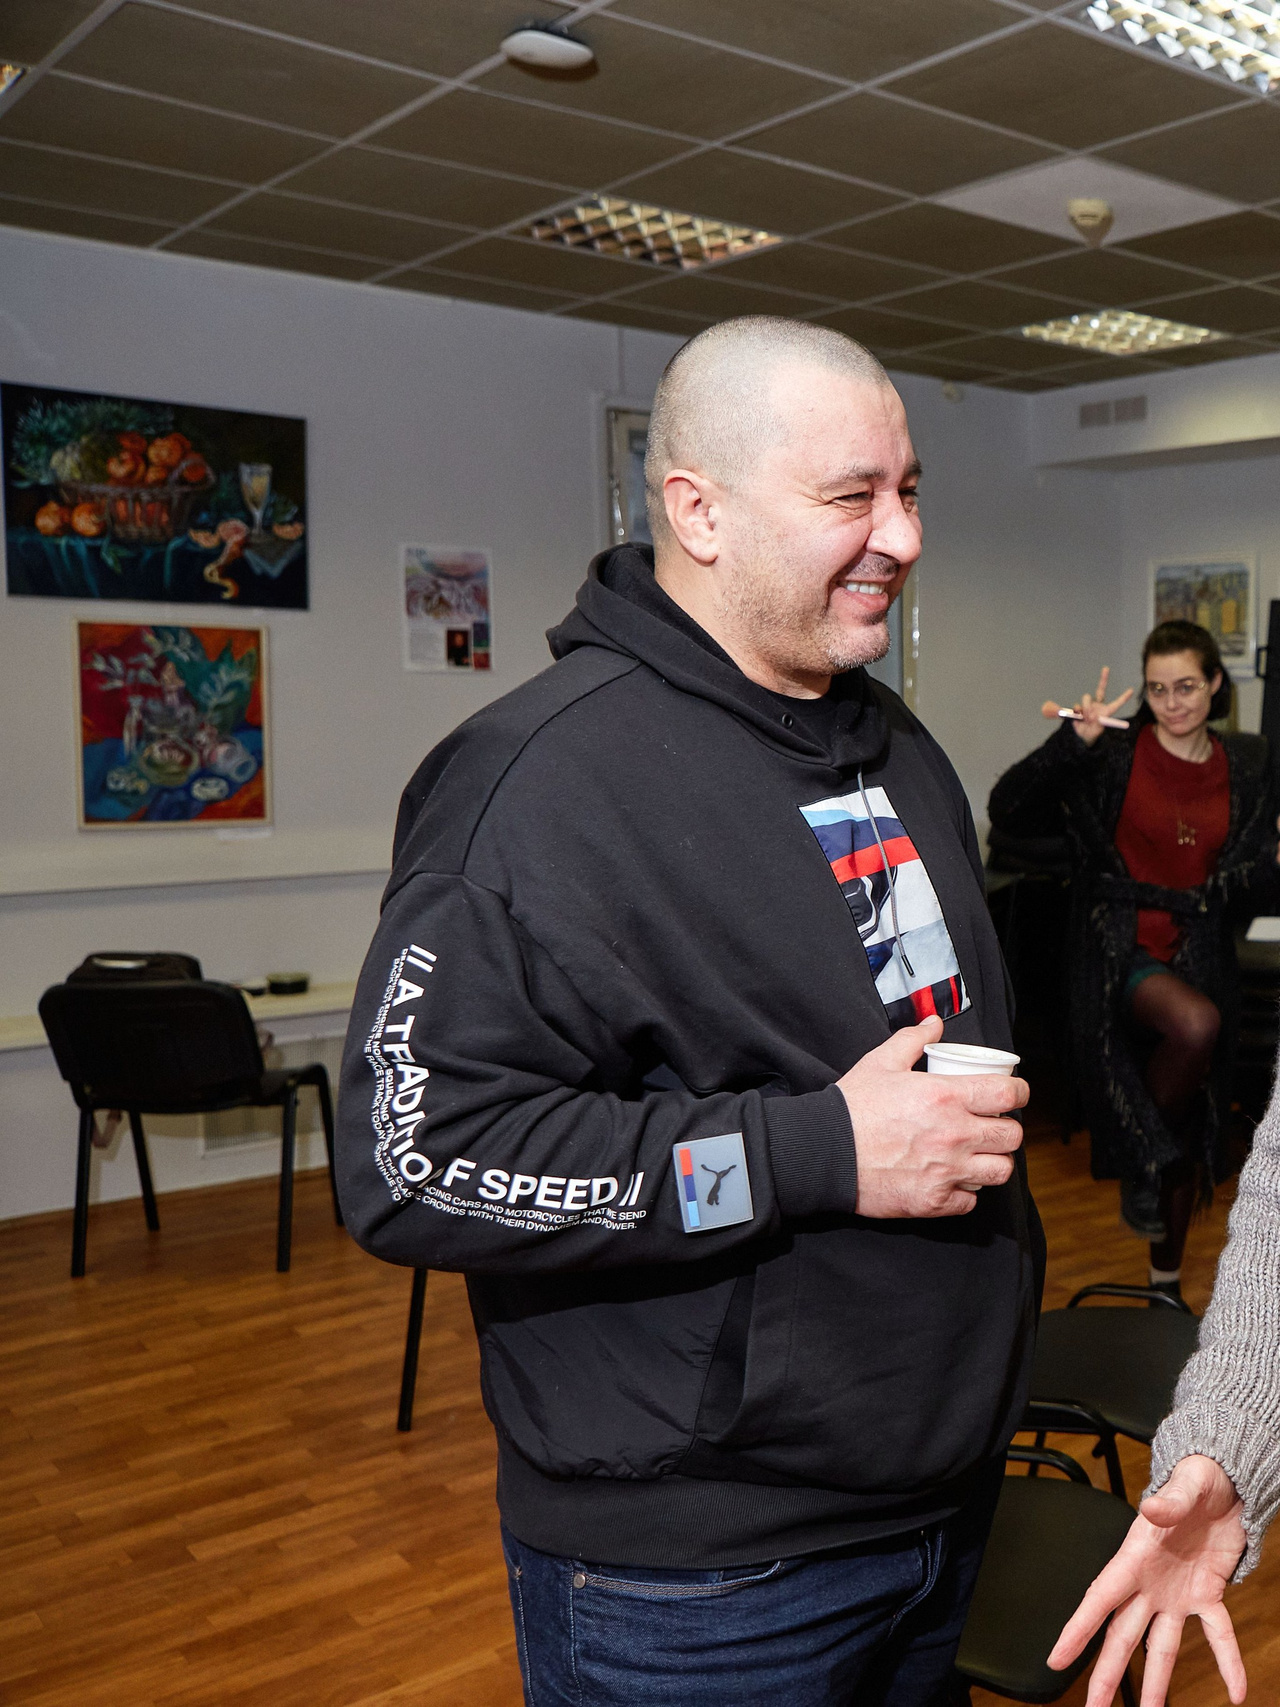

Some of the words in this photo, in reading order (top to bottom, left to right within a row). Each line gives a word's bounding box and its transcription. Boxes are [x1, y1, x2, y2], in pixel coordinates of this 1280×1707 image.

[392, 978, 425, 1007] A
[371, 1005, 385, 1032] ONTO
[363, 1034, 375, 1053] THE
[365, 1054, 384, 1077] RACE
[370, 1077, 384, 1109] TRACK
[375, 1003, 391, 1039] ENGINE
[383, 1156, 399, 1176] THE
[383, 1014, 446, 1188] TRADITIO
[371, 1109, 387, 1140] TODAY
[374, 1140, 397, 1187] CONTINUE
[390, 1186, 402, 1202] TO
[423, 1185, 453, 1201] ACING
[452, 1196, 482, 1209] CARS
[482, 1202, 505, 1214] AND
[505, 1207, 581, 1224] MOTORCYCLES
[583, 1207, 607, 1218] THAT
[618, 1210, 647, 1221] SEND
[477, 1168, 619, 1211] SPEED
[422, 1194, 466, 1216] CROWDS
[467, 1209, 494, 1221] WITH
[495, 1215, 526, 1228] THEIR
[526, 1219, 580, 1232] DYNAMISM
[581, 1216, 603, 1225] AND
[602, 1217, 638, 1231] POWER.
